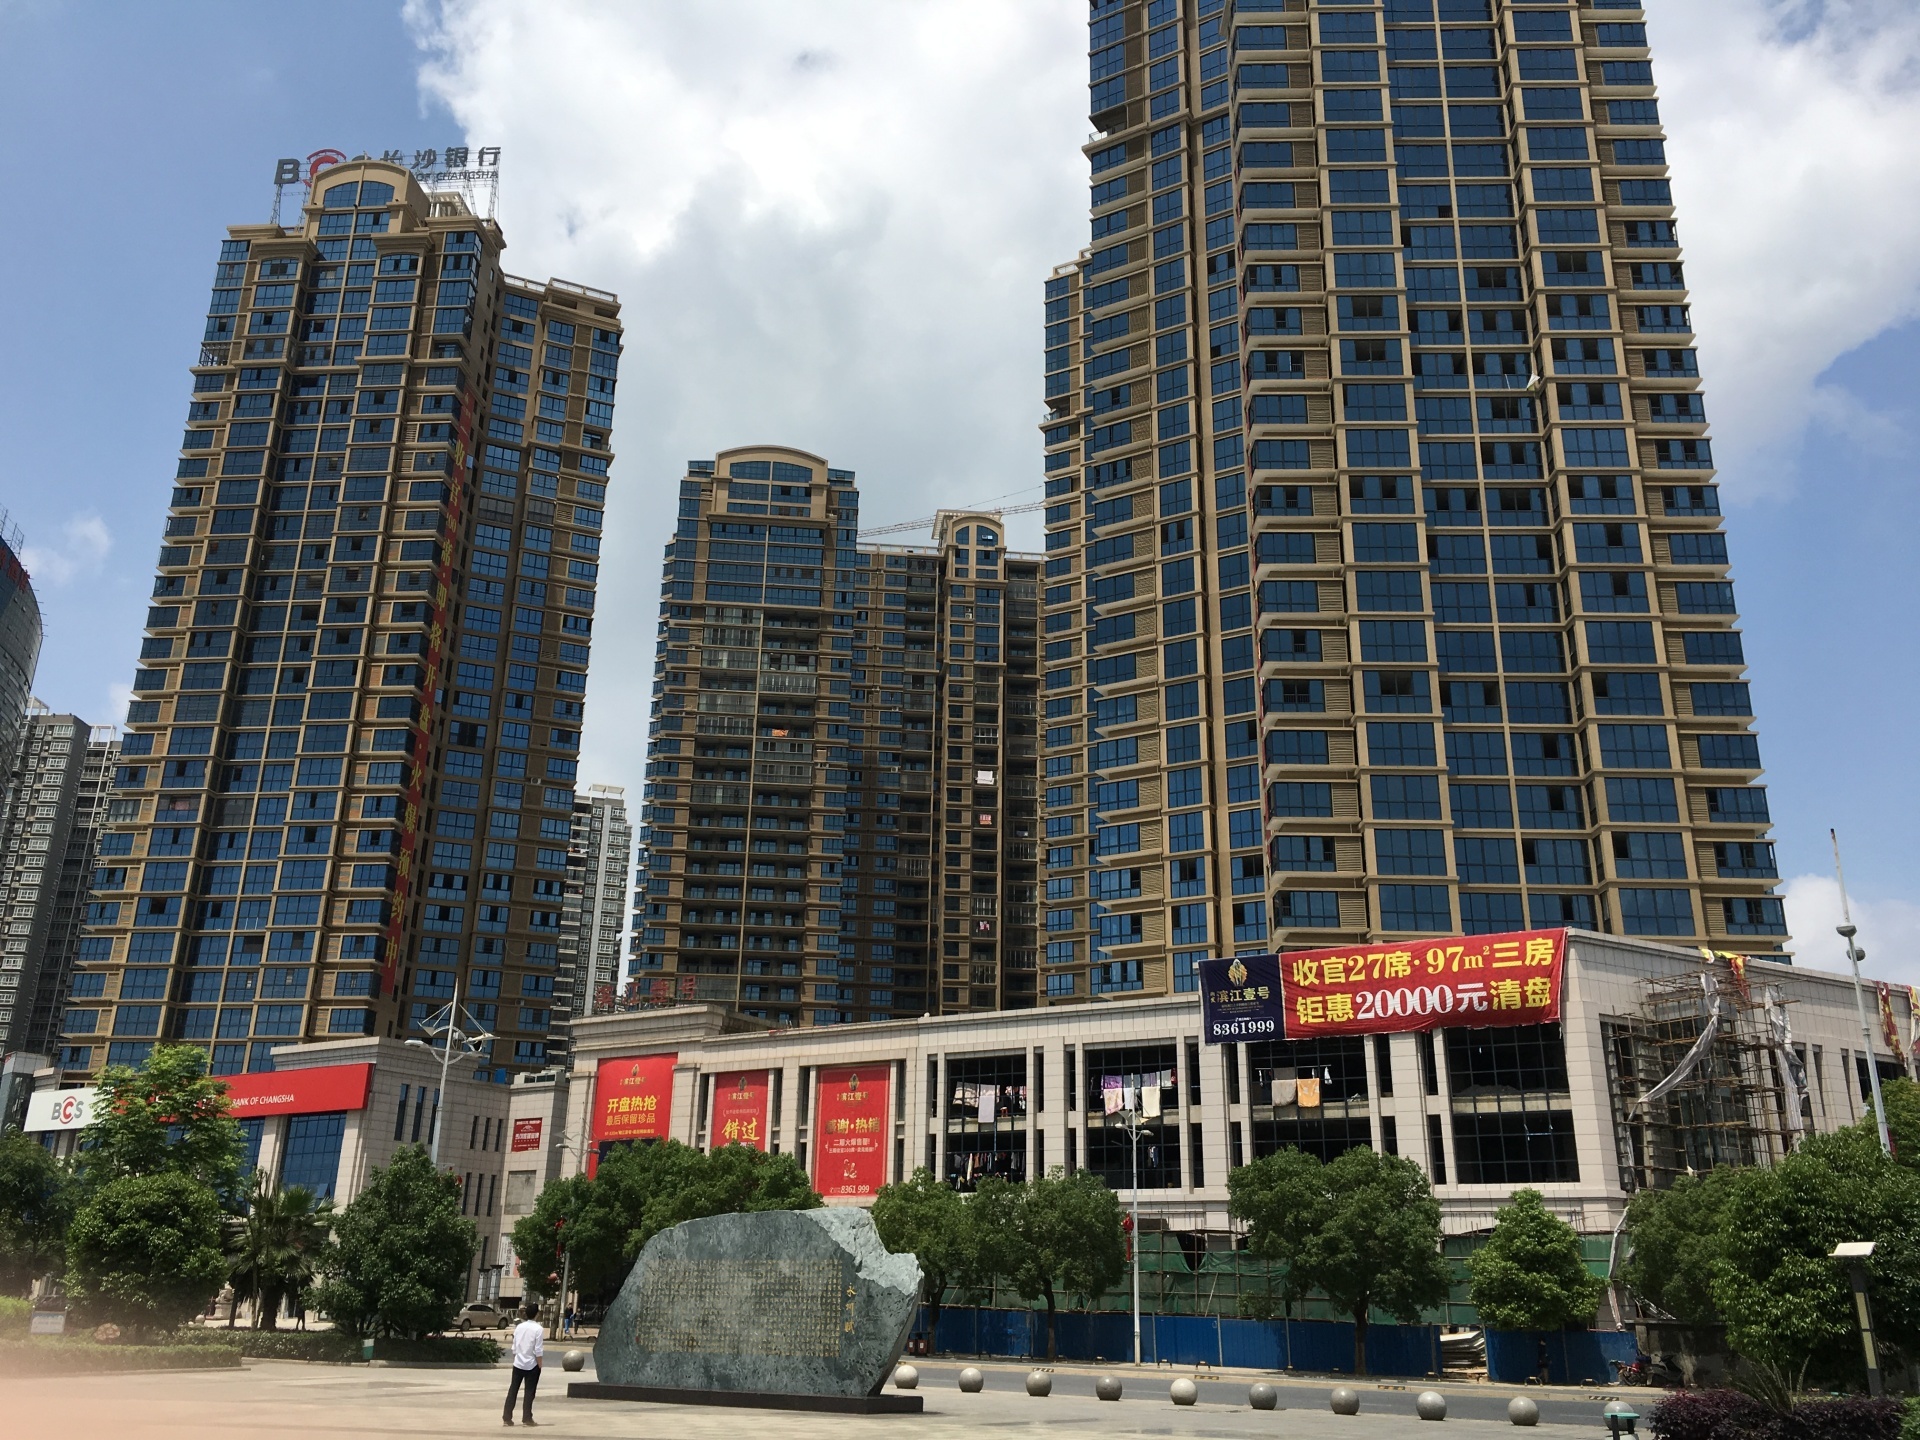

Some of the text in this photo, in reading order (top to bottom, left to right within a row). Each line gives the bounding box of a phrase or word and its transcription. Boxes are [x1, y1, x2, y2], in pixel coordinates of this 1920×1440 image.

[379, 146, 502, 170] 长沙银行
[436, 170, 499, 181] CHANGSHA
[1217, 986, 1270, 1003] 滨江壹号
[1296, 976, 1552, 1025] 钜惠20000元清盘
[1213, 1020, 1275, 1036] 8361999
[250, 1095, 259, 1105] OF
[259, 1093, 294, 1105] CHANGSHA
[607, 1095, 657, 1113] 开盘热抢
[51, 1098, 84, 1122] BCS
[606, 1112, 656, 1126] 最后保留珍品
[721, 1117, 760, 1141] 错过
